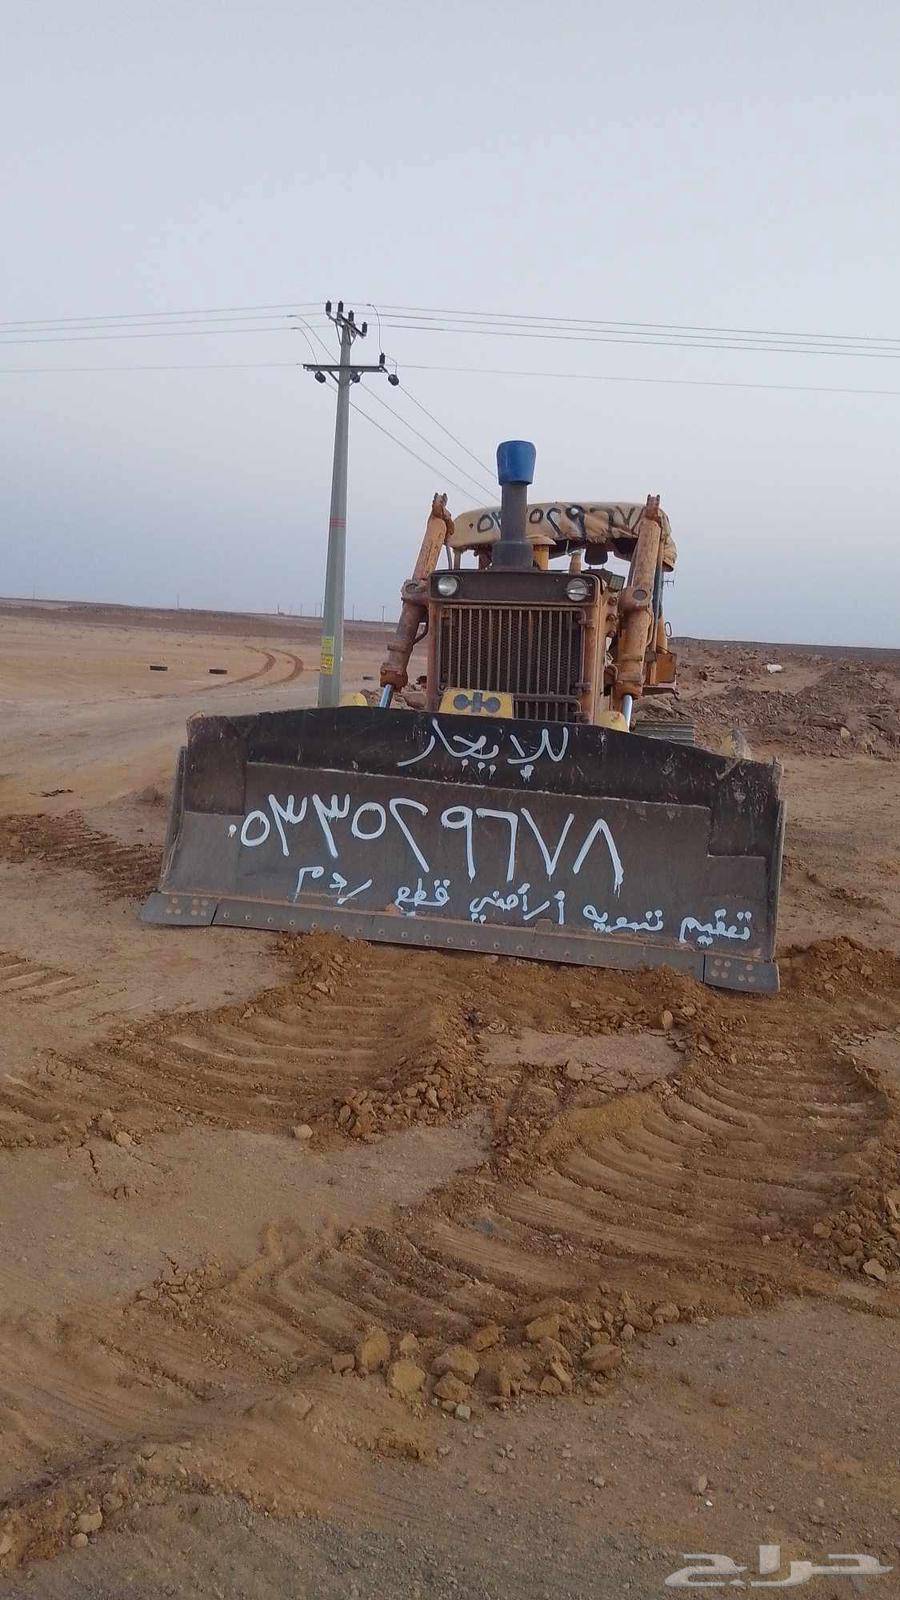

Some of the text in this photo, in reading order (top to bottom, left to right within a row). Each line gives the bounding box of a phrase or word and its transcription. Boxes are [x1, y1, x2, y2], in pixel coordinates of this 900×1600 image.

[228, 793, 625, 898] ٠٥٣٣٥٢٩٦٧٨
[293, 866, 372, 905] ردم
[394, 878, 451, 917] قطع
